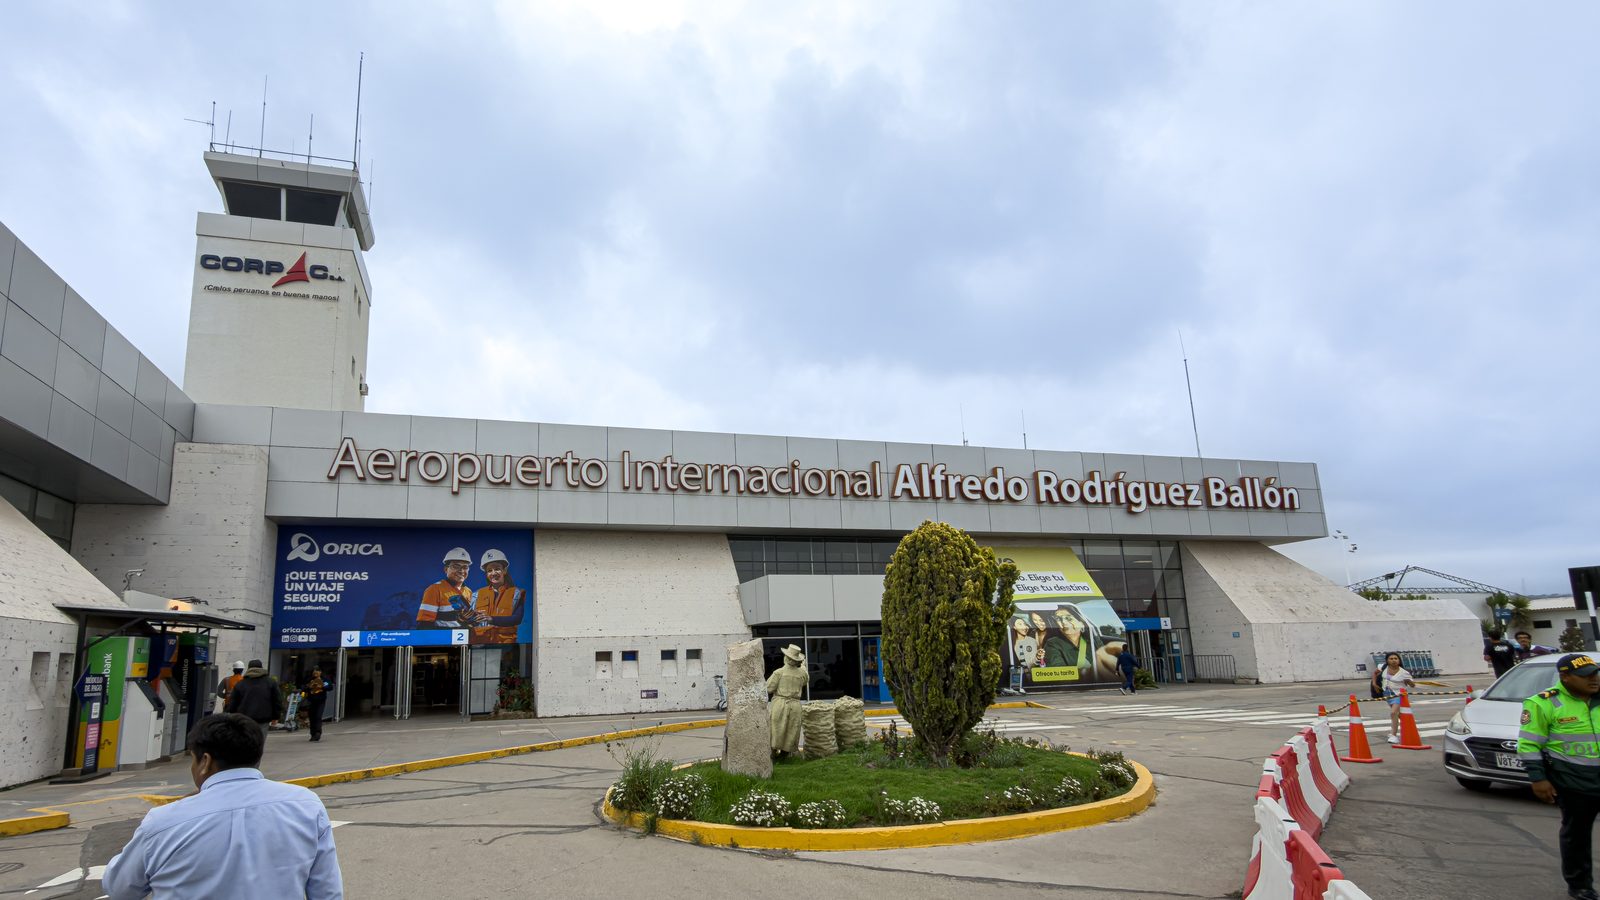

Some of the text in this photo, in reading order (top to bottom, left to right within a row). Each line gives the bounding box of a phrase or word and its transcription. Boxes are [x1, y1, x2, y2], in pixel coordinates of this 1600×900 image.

[233, 286, 269, 296] peruanos
[283, 290, 310, 299] buenas
[327, 437, 1300, 513] Aeropuerto Internacional Alfredo Rodríguez Ballón
[323, 542, 384, 556] ORICA
[285, 571, 369, 582] ¡QUE TENGAS
[1028, 573, 1051, 583] Elige
[285, 582, 345, 591] UN VIAJE
[1016, 584, 1040, 593] Elige
[1054, 583, 1090, 592] destino
[284, 593, 340, 602] SEGURO!
[457, 632, 465, 641] 2
